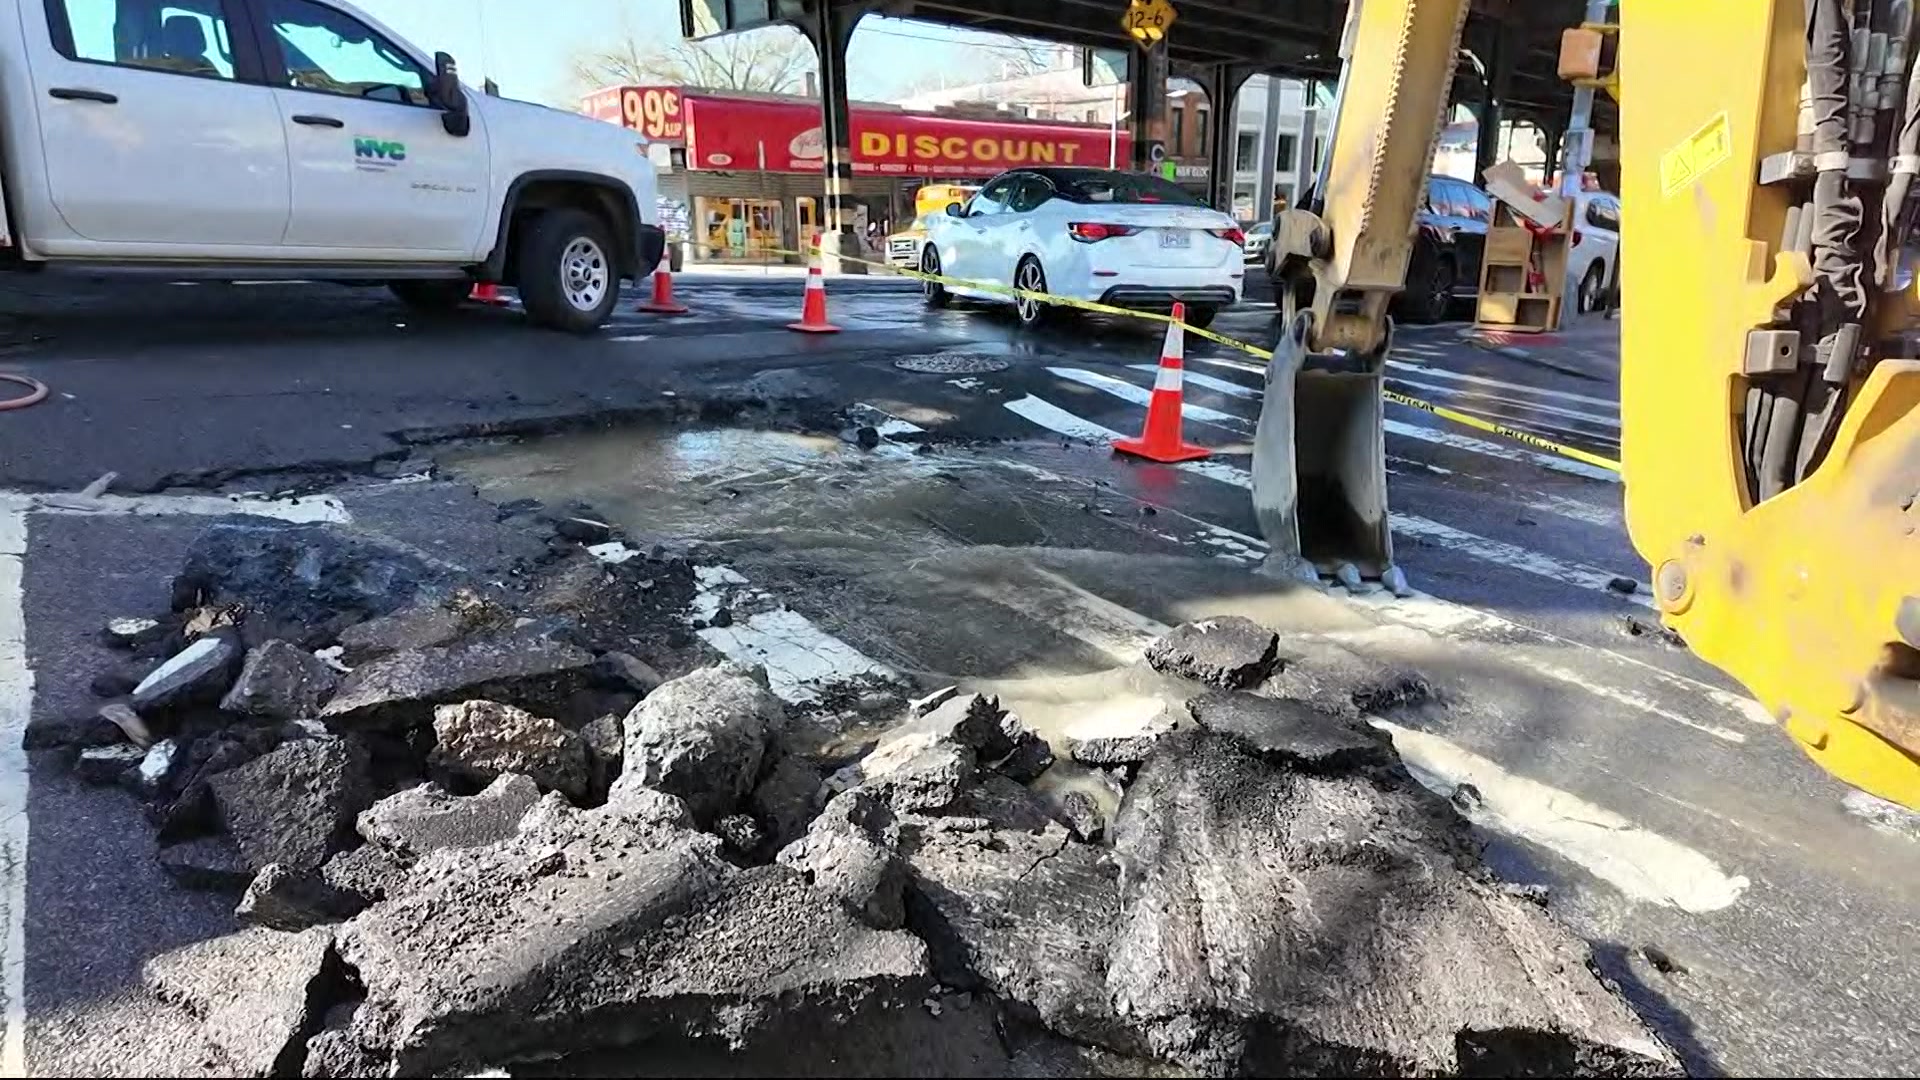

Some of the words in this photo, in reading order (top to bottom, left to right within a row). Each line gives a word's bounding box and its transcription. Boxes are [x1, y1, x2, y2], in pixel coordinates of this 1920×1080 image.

[1129, 10, 1164, 28] 12-6
[354, 138, 406, 161] NYC
[861, 132, 1080, 163] DISCOUNT
